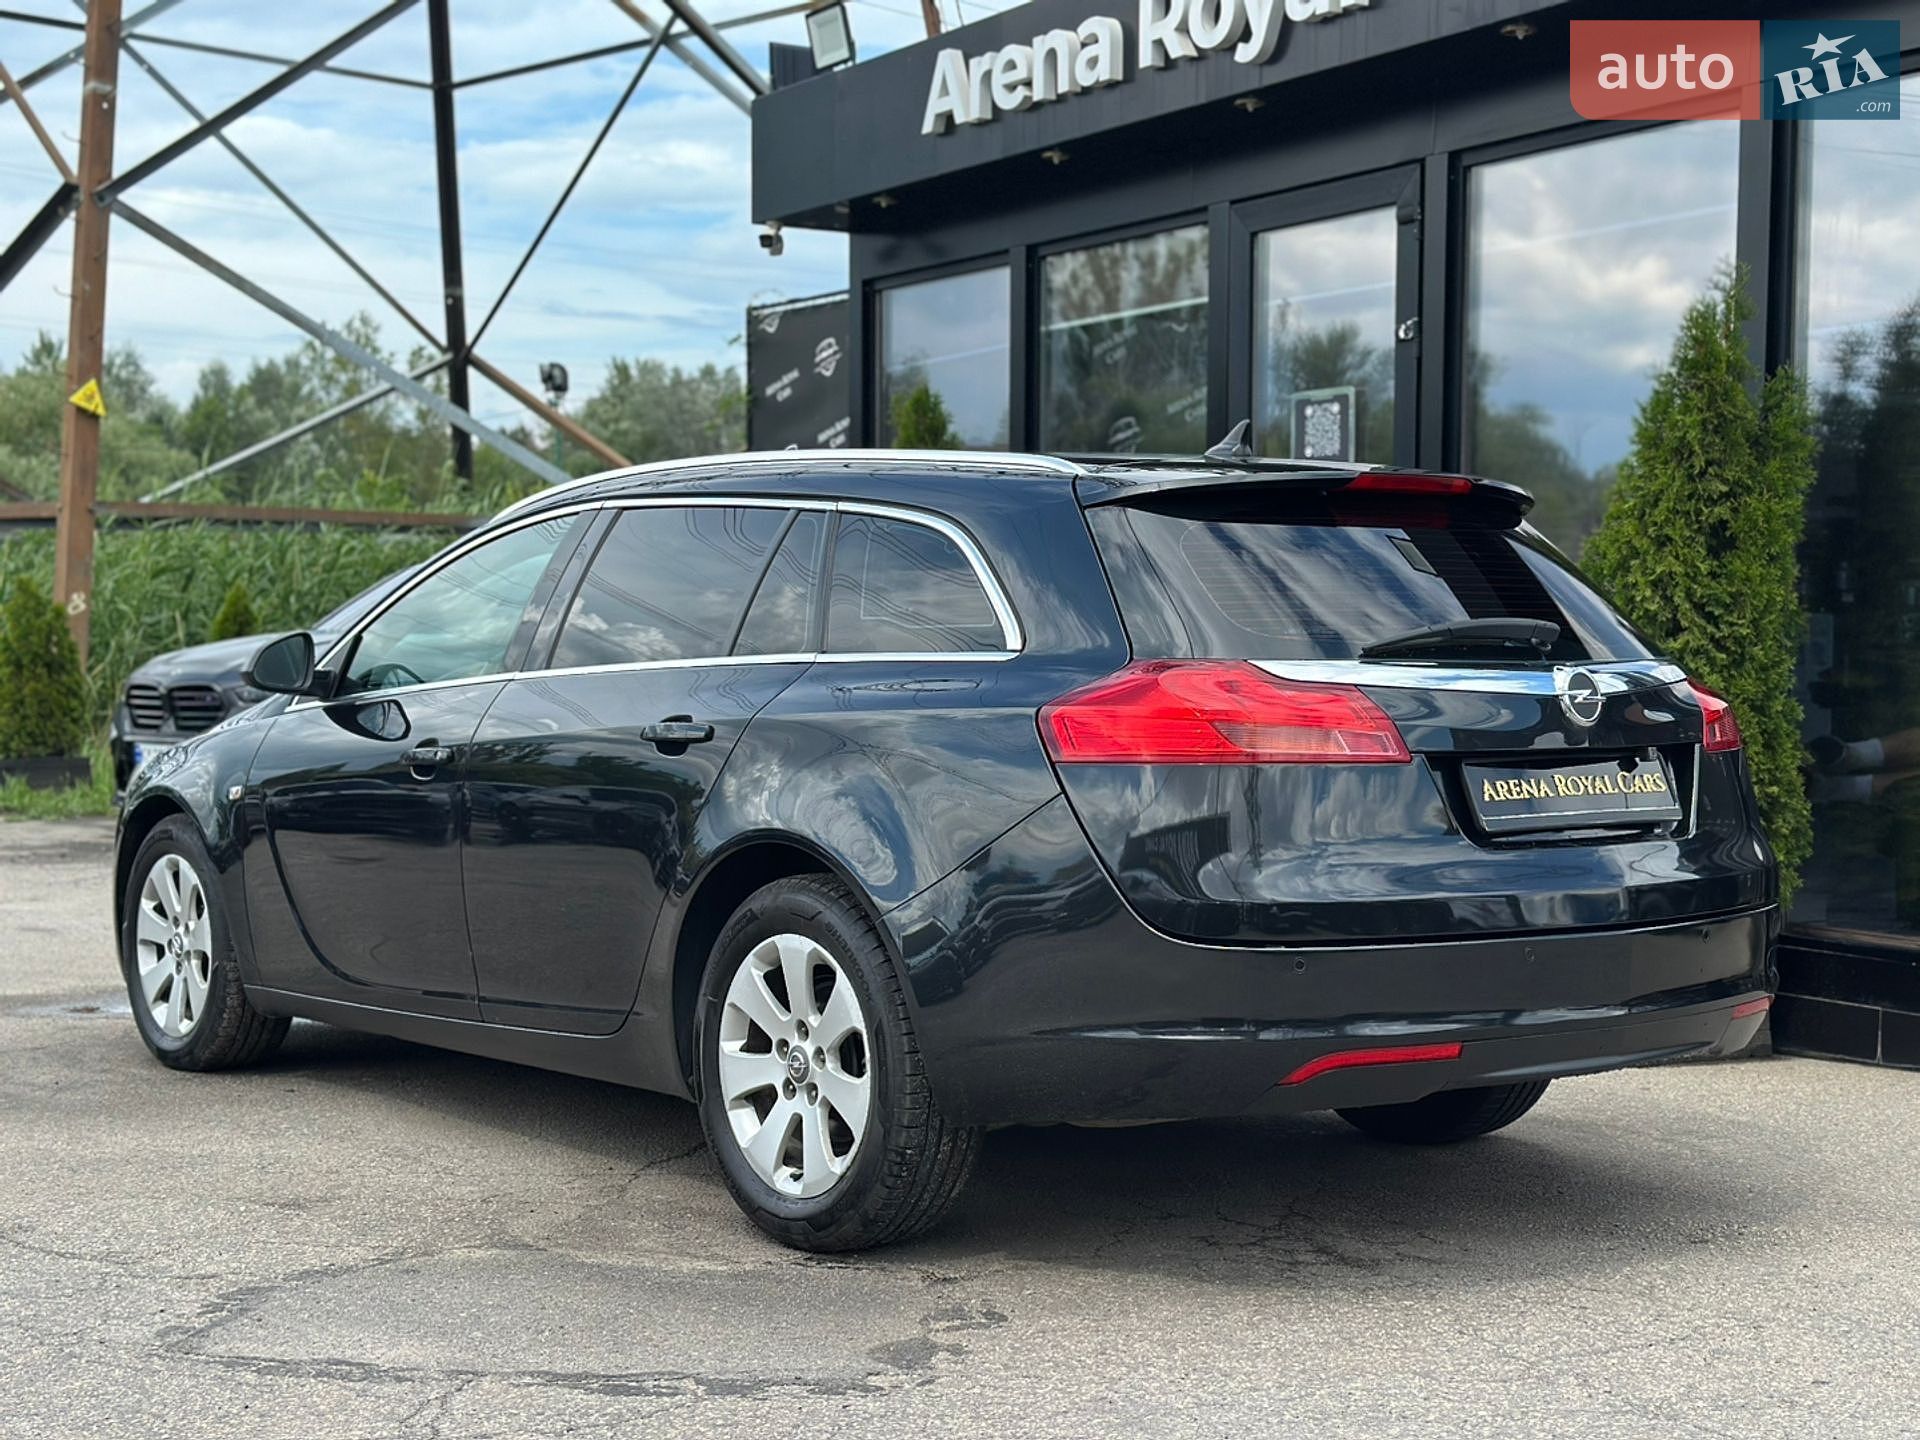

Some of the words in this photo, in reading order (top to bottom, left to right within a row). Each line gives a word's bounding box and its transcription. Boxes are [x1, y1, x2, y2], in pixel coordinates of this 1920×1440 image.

[920, 15, 1124, 135] Arena
[1138, 0, 1370, 69] Roy
[1482, 777, 1554, 802] ARENA
[1553, 774, 1618, 797] ROYAL
[1616, 771, 1668, 794] CARS
